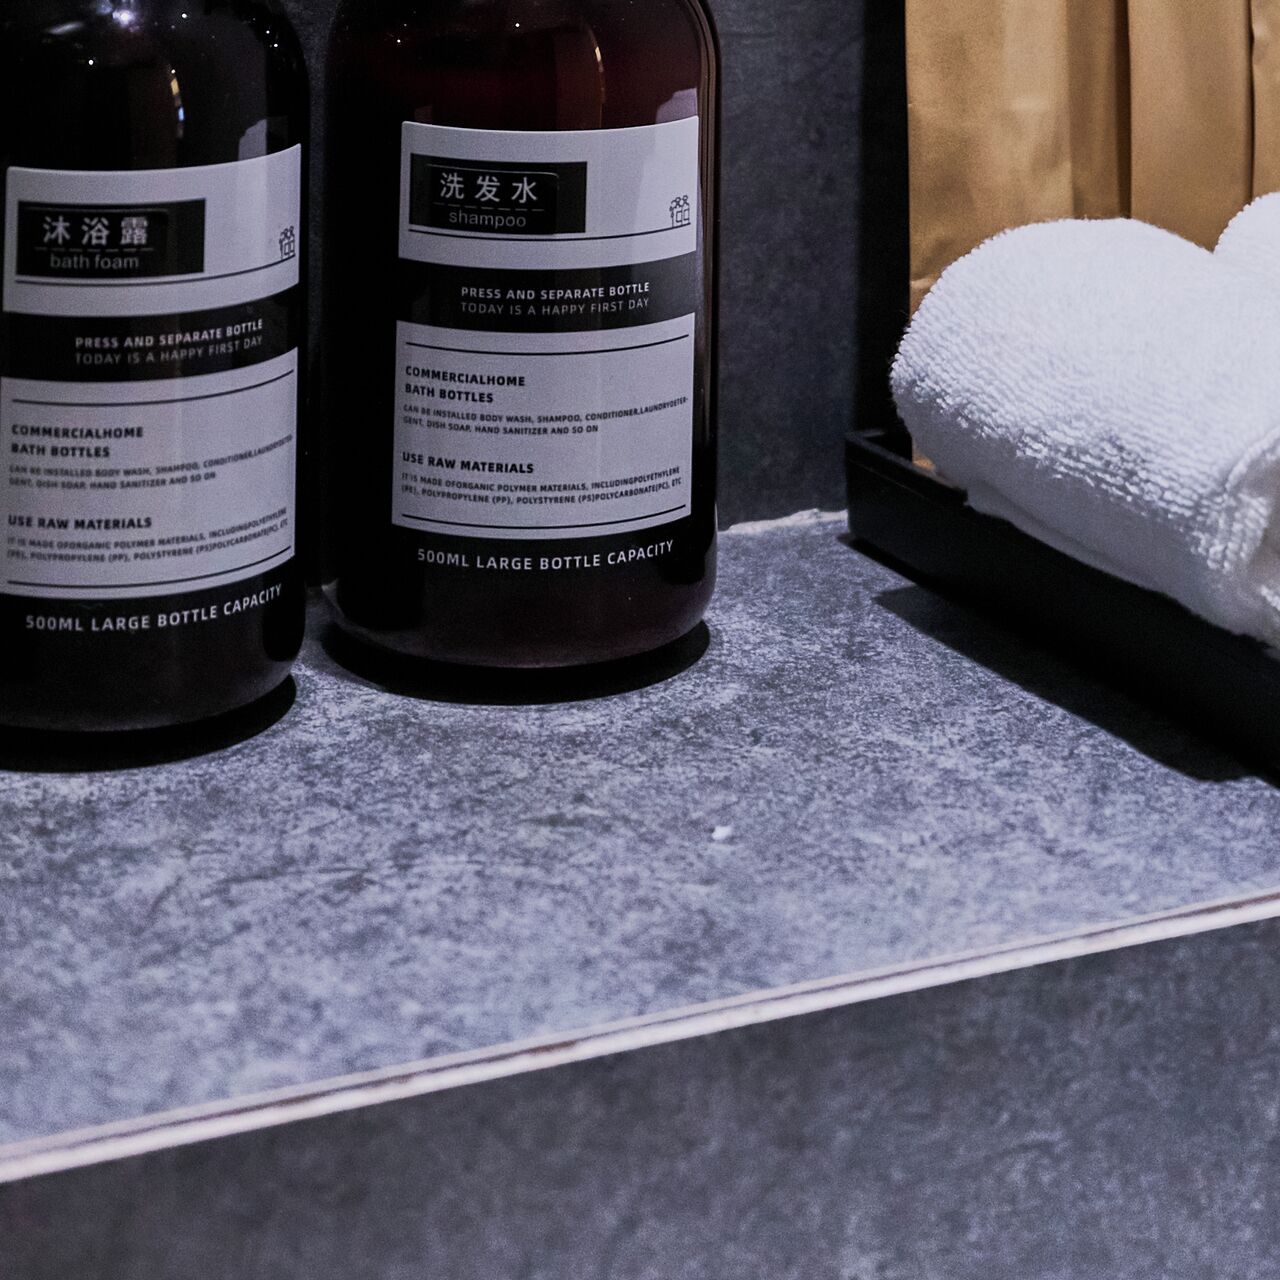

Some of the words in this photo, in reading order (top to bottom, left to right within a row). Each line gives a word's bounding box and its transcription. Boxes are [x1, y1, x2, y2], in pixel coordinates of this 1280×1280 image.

[440, 172, 538, 203] 洗发水
[448, 210, 527, 229] shampoo
[42, 215, 148, 245] 沐浴露
[50, 253, 89, 269] bath
[95, 254, 139, 269] foam
[461, 287, 501, 299] PRESS
[506, 290, 535, 300] AND
[541, 287, 604, 300] SEPARATE
[609, 282, 650, 297] BOTTLE
[461, 302, 504, 315] TODAY
[510, 305, 521, 316] IS
[528, 305, 536, 316] A
[542, 303, 585, 316] HAPPY
[591, 301, 623, 313] FIRST
[628, 297, 649, 310] DAY
[75, 337, 118, 349] PRESS
[124, 335, 154, 348] AND
[159, 328, 221, 345] SEPARATE
[226, 319, 263, 337] BOTTLE
[75, 352, 120, 365] TODAY
[128, 352, 140, 364] IS
[145, 351, 155, 363] A
[160, 347, 203, 361] HAPPY
[209, 340, 239, 356] FIRST
[243, 335, 262, 349] DAY
[405, 366, 525, 386] COMMERCIALHOME
[405, 383, 435, 397] BATH
[440, 389, 494, 403] BOTTLES
[403, 404, 419, 413] CAN
[433, 409, 477, 421] INSTALLED
[480, 414, 502, 422] BODY
[11, 424, 143, 438] COMMERCIALHOME
[427, 420, 446, 428] DISH
[475, 425, 500, 434] HAND
[503, 427, 548, 435] SANITIZER
[551, 426, 569, 434] AND
[11, 443, 45, 456] BATH
[51, 446, 110, 457] BOTTLES
[402, 452, 423, 465] USE
[428, 456, 456, 469] RAW
[461, 460, 534, 473] MATERIALS
[421, 476, 442, 487] MADE
[497, 484, 537, 492] POLYMER
[421, 489, 489, 503] POLYPROPYLENE
[516, 496, 575, 504] POLYSTYRENE
[672, 477, 682, 487] ETC
[8, 515, 32, 527] USE
[38, 517, 68, 529] RAW
[74, 517, 152, 529] MATERIALS
[418, 549, 469, 567] 500ML
[476, 556, 532, 570] LARGE
[540, 554, 600, 570] BOTTLE
[607, 539, 673, 565] CAPACITY
[25, 615, 84, 631] 500ML
[91, 615, 150, 631] LARGE
[157, 605, 217, 627] BOTTLE
[223, 584, 282, 615] CAPACITY
